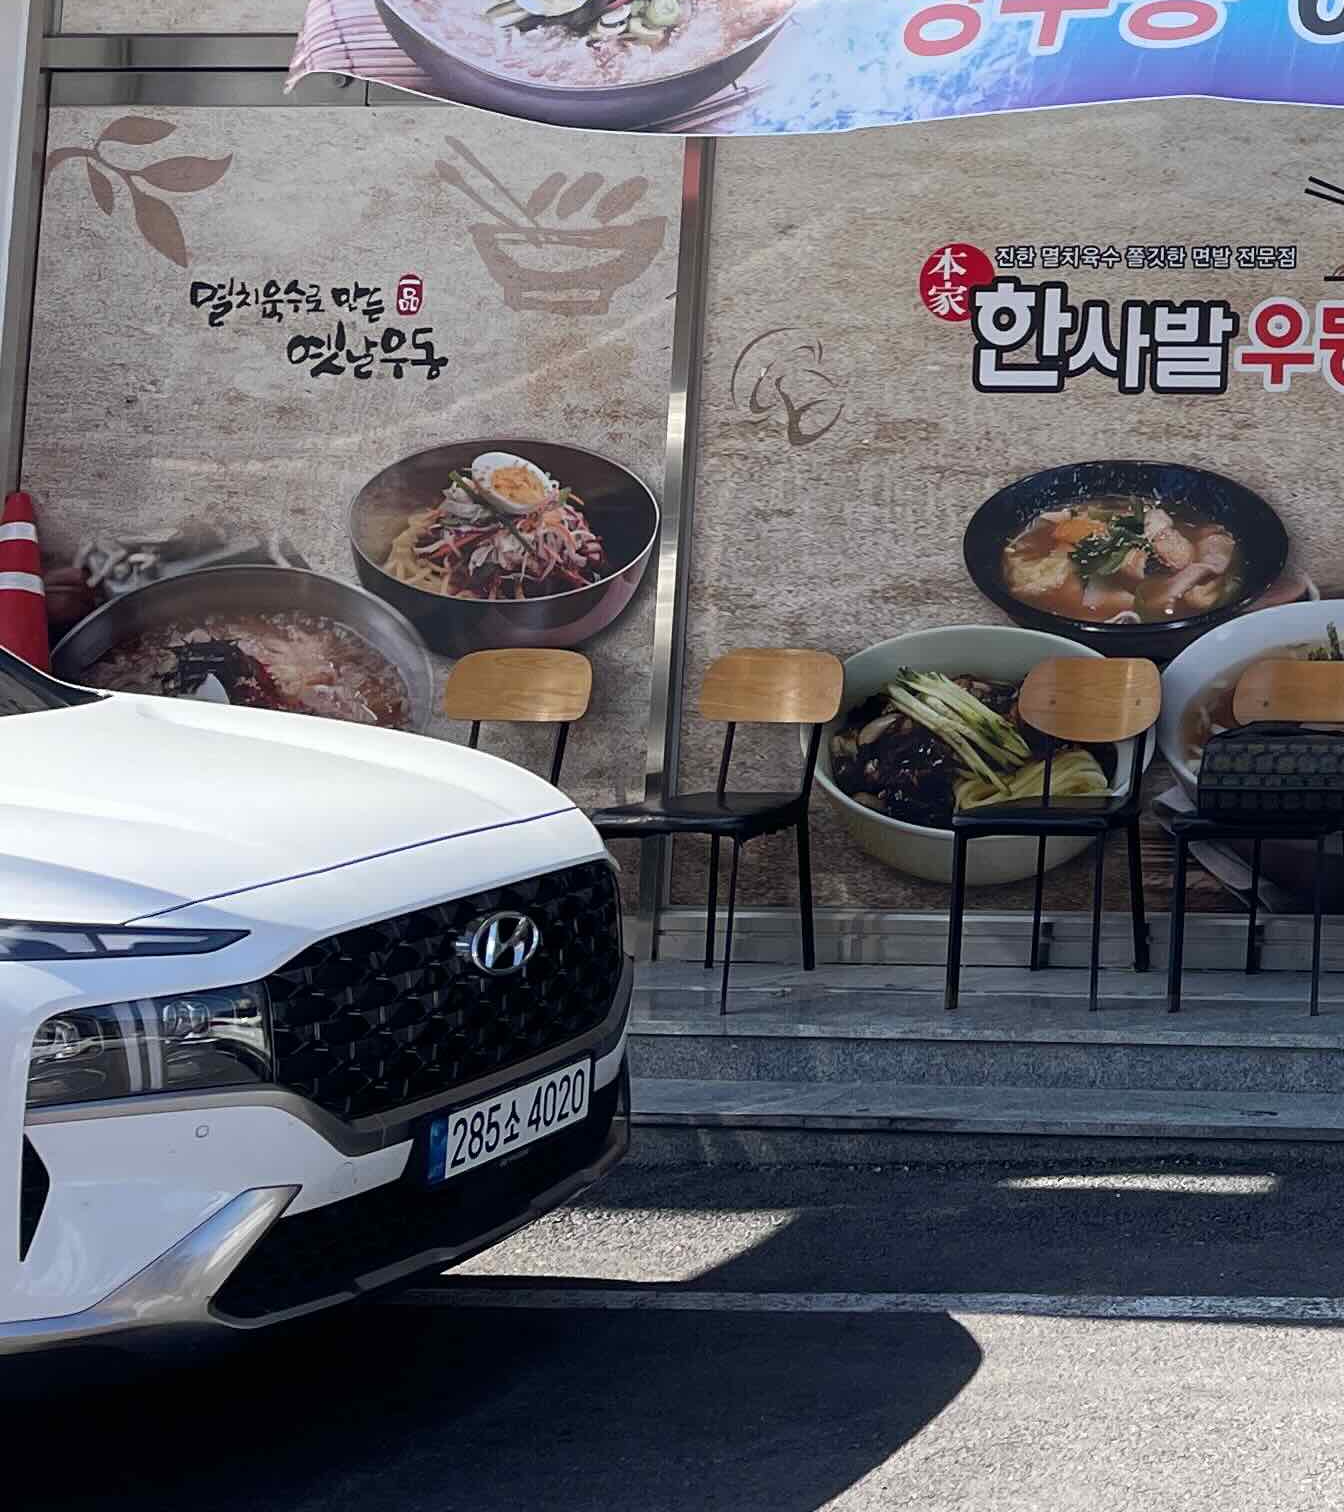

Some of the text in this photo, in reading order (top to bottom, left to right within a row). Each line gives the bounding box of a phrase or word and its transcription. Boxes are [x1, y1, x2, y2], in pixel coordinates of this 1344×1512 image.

[928, 247, 968, 316] 本家
[996, 245, 1297, 269] 진한 멸치육수 쫄깃한 면발 전문점
[188, 276, 326, 326] 멸치육수로
[331, 279, 385, 322] 만든
[286, 322, 449, 380] 옛날우동
[450, 1068, 586, 1169] 285소 4020
